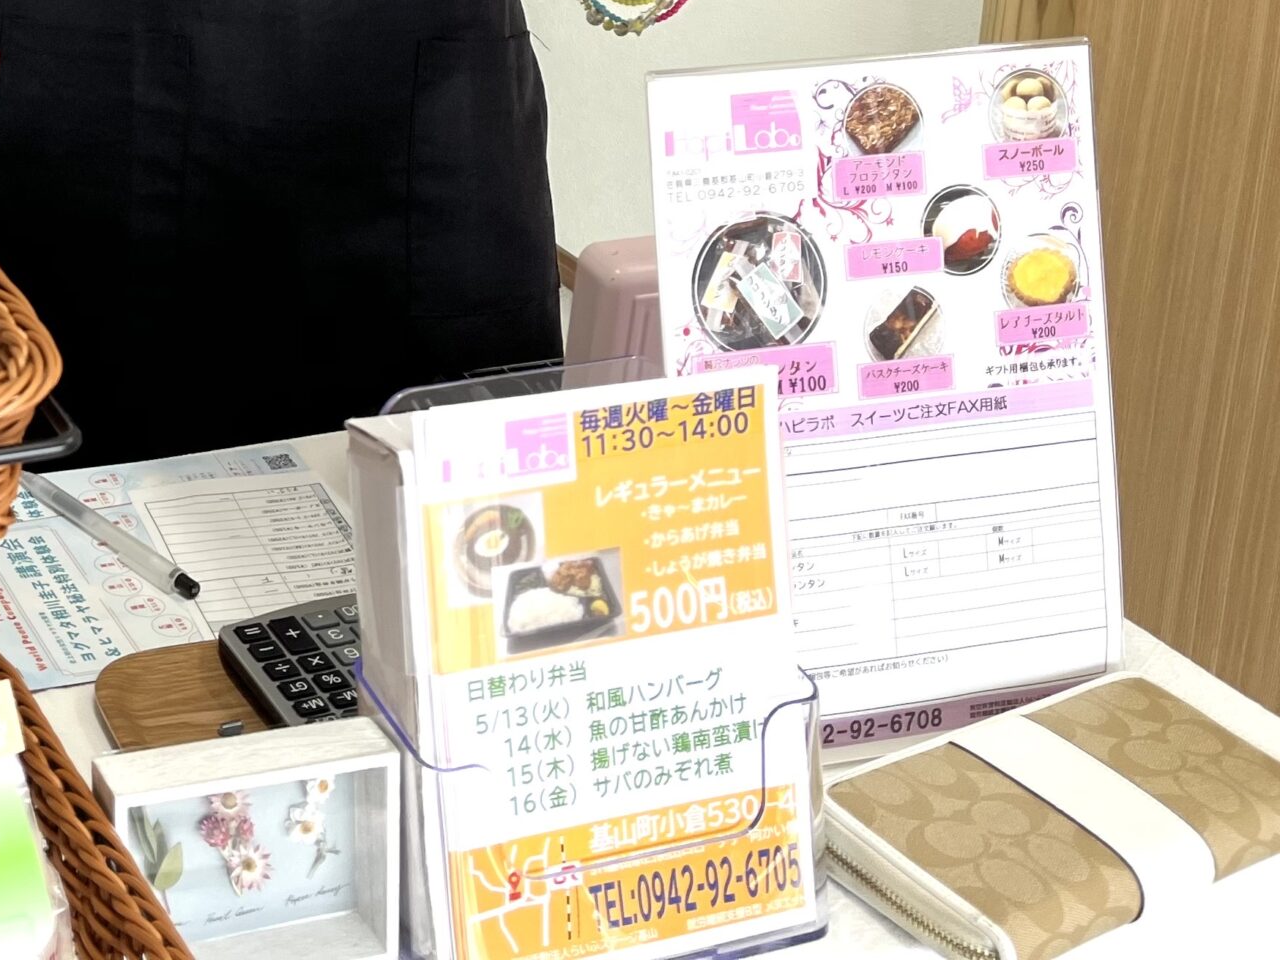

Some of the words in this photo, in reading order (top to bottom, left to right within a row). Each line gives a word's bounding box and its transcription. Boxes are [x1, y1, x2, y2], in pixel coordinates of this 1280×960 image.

[854, 156, 905, 169] アーモンド
[998, 145, 1065, 161] スノーボール
[849, 169, 912, 183] フロランタン
[1019, 160, 1045, 172] ¥250
[855, 185, 877, 195] ¥200
[896, 181, 918, 191] ¥100
[861, 244, 928, 260] レモンケーキ
[882, 262, 908, 274] ¥150
[1000, 310, 1085, 330] レアチーズタルト
[1031, 326, 1056, 338] ¥200
[985, 358, 1082, 376] ギフト用梱包も承ります。
[789, 375, 827, 395] ¥100
[894, 380, 919, 393] ¥200
[850, 396, 1008, 428] スイーツご注文FAX用紙
[594, 466, 762, 507] レギュラーメニュー
[11, 621, 31, 644] Peace
[23, 645, 47, 671] World
[467, 661, 588, 703] 日替わり弁当
[475, 697, 572, 735] 5/13(火)
[586, 668, 723, 714] 和風ハンバーグ
[504, 726, 573, 758] 14(水)
[589, 694, 748, 742] 魚の甘酢あんかけ
[507, 754, 576, 787] 15(木)
[590, 719, 766, 772] 揚げない鶏南蛮漬け
[510, 783, 578, 817] 16(金)
[593, 754, 734, 798] サバのみぞれ煮
[588, 843, 802, 932] TEL:0942-92-6705
